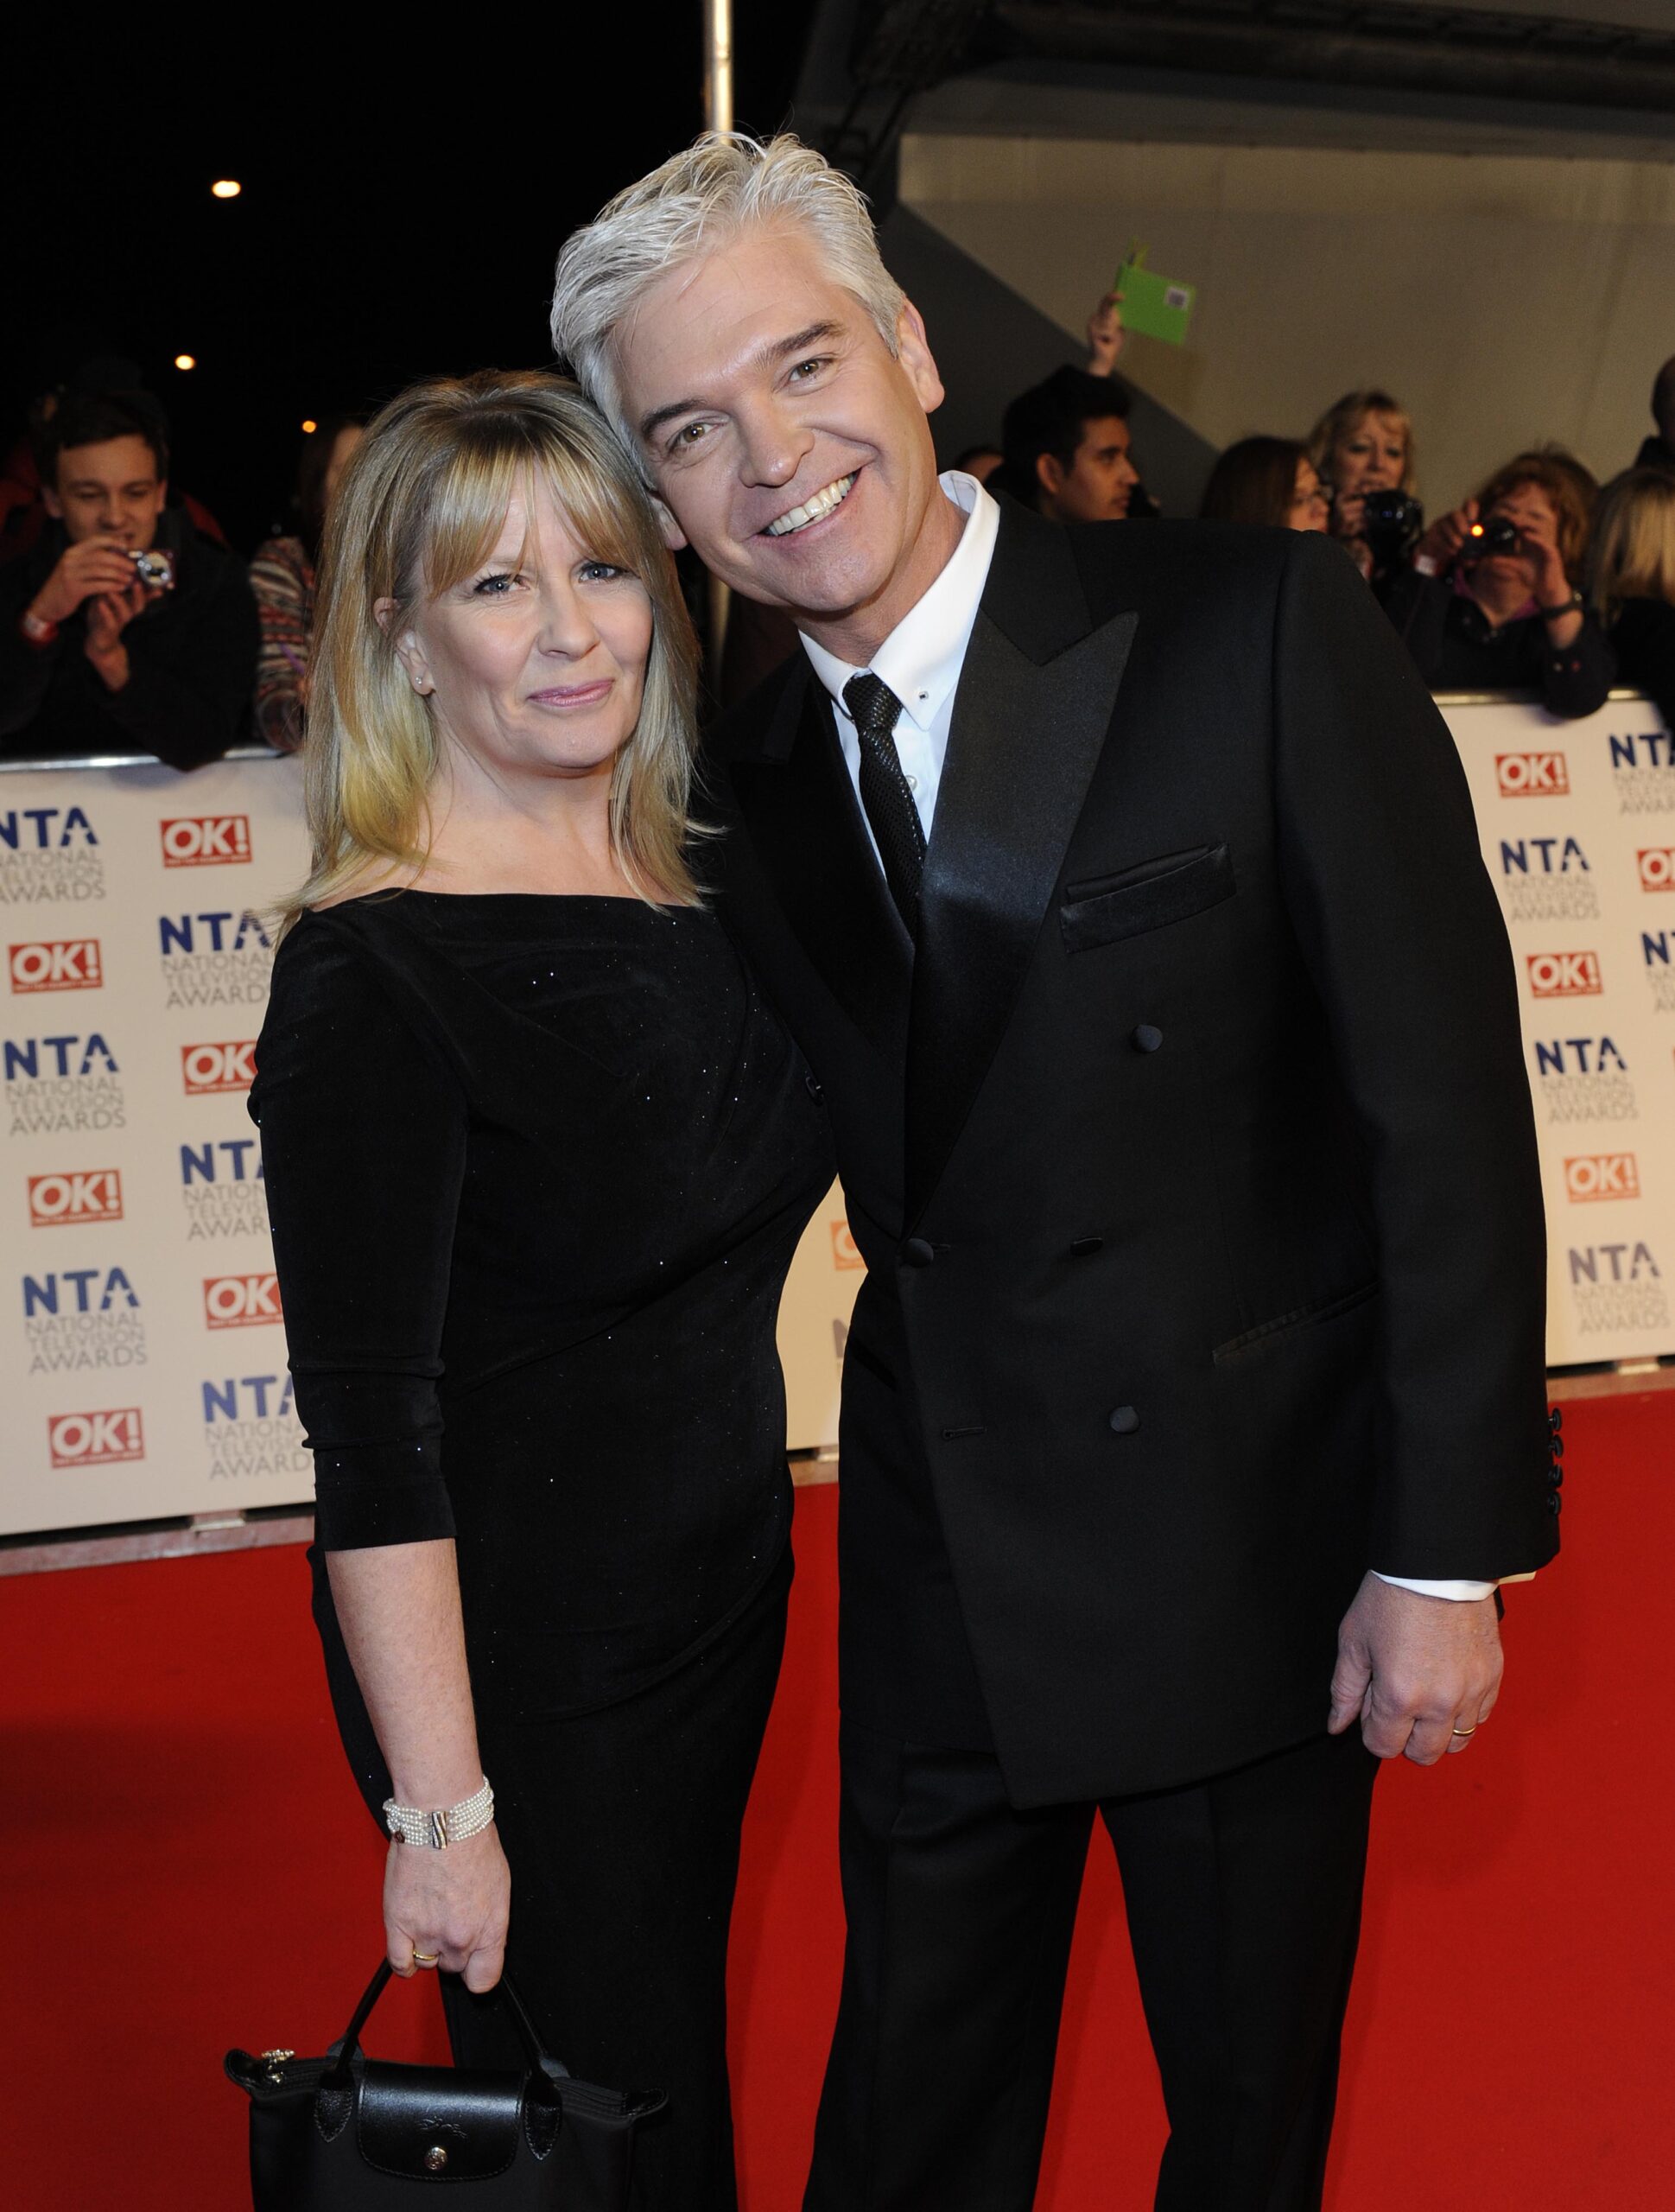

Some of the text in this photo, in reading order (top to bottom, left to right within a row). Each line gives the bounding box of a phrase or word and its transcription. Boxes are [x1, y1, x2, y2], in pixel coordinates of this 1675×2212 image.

[1608, 734, 1675, 767] NT
[1501, 757, 1565, 788] OK!
[165, 819, 248, 858] OK!
[1501, 837, 1589, 874] NTA
[0, 849, 101, 868] ATIONAL
[160, 910, 270, 955] NTA
[13, 942, 98, 983] OK!
[1532, 955, 1597, 989] OK!
[166, 983, 269, 1009] AWARD
[4, 1033, 119, 1080] NTA
[186, 1044, 256, 1084] OK
[1535, 1036, 1627, 1075] NTA
[5, 1077, 121, 1100] NATIONAL
[9, 1107, 127, 1136] AWARDS
[181, 1141, 263, 1185] NT
[1570, 1158, 1634, 1192] OK!
[33, 1173, 119, 1216] OK!
[182, 1184, 264, 1206] NATION
[187, 1214, 269, 1242] AWAR
[1569, 1242, 1660, 1284] NTA
[23, 1267, 140, 1316] NTA
[208, 1278, 278, 1319] OK
[25, 1313, 143, 1337] NATIONAL
[29, 1344, 148, 1375] AWARDS
[54, 1411, 141, 1458] OK!
[210, 1450, 311, 1479] AWARD
